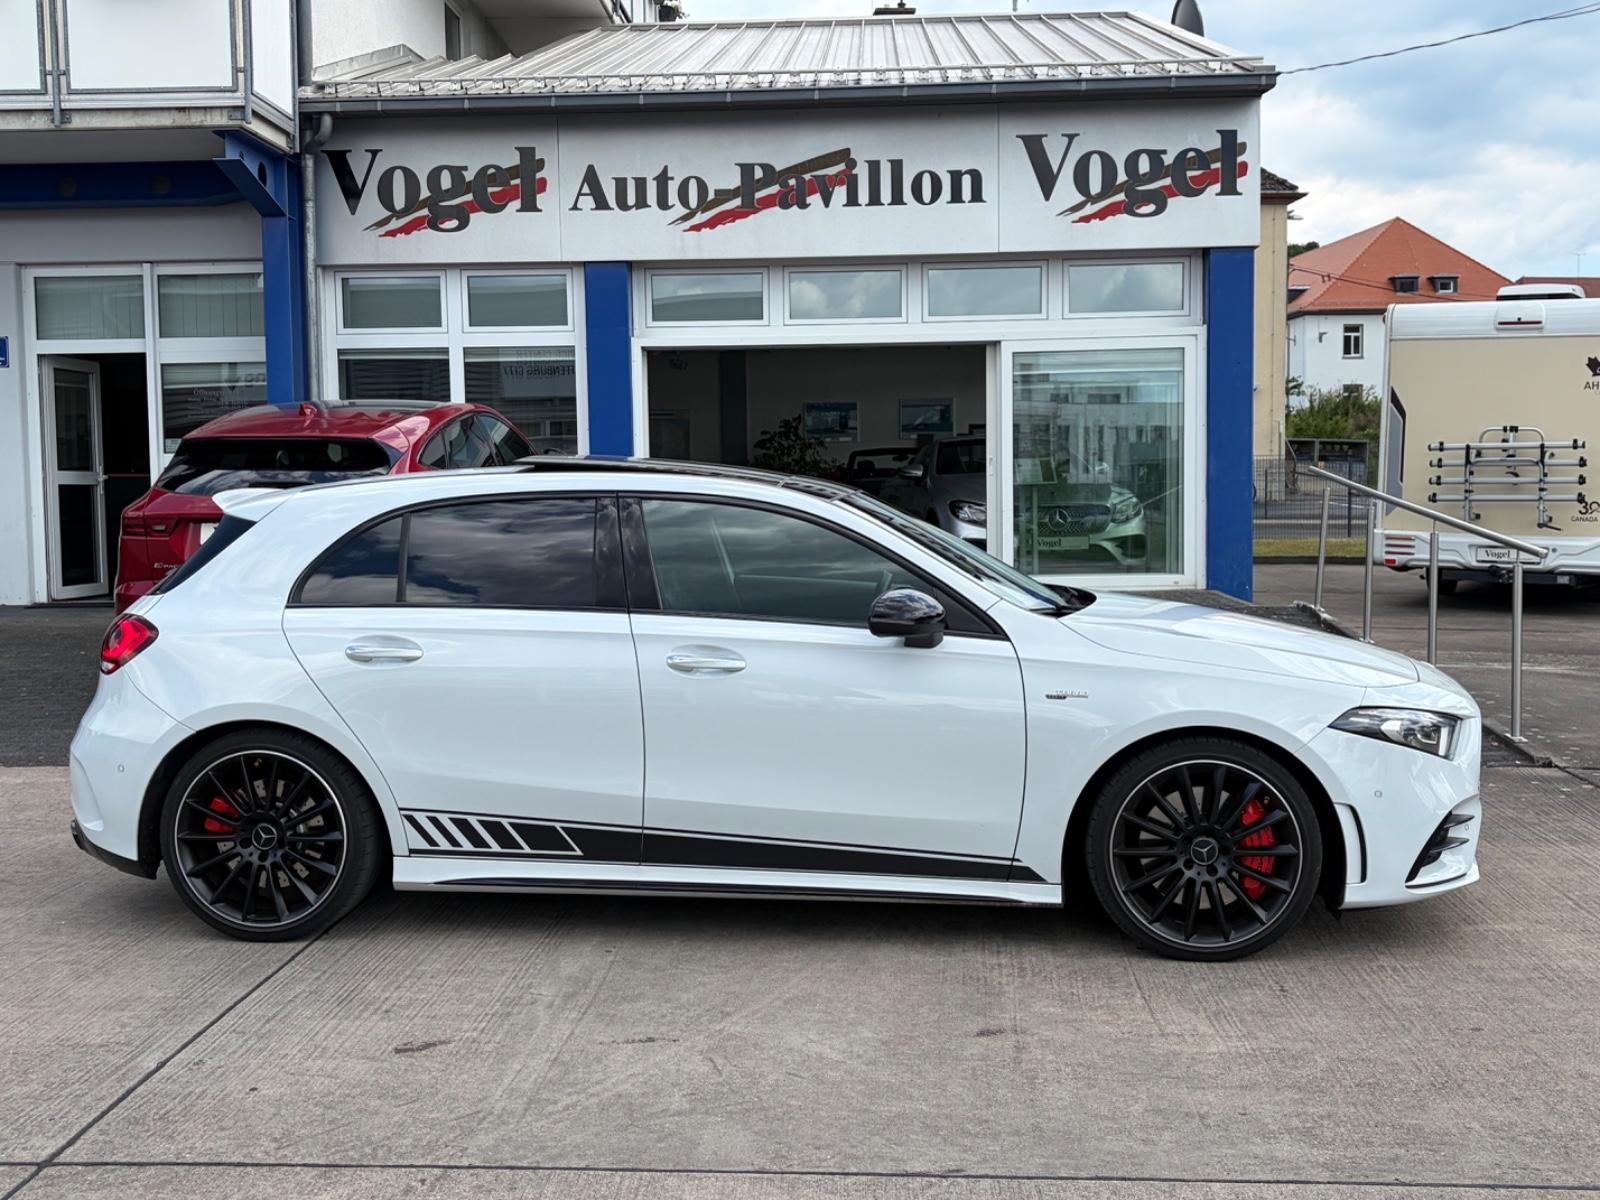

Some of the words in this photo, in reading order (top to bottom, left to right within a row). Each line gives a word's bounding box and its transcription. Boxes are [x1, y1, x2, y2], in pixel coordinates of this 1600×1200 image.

[321, 147, 543, 233] Vogel
[568, 157, 988, 212] Auto-Pavillon
[1016, 129, 1243, 218] Vogel
[1571, 515, 1599, 523] CANADA
[1037, 538, 1062, 548] Vogel
[1484, 549, 1511, 560] Vogel
